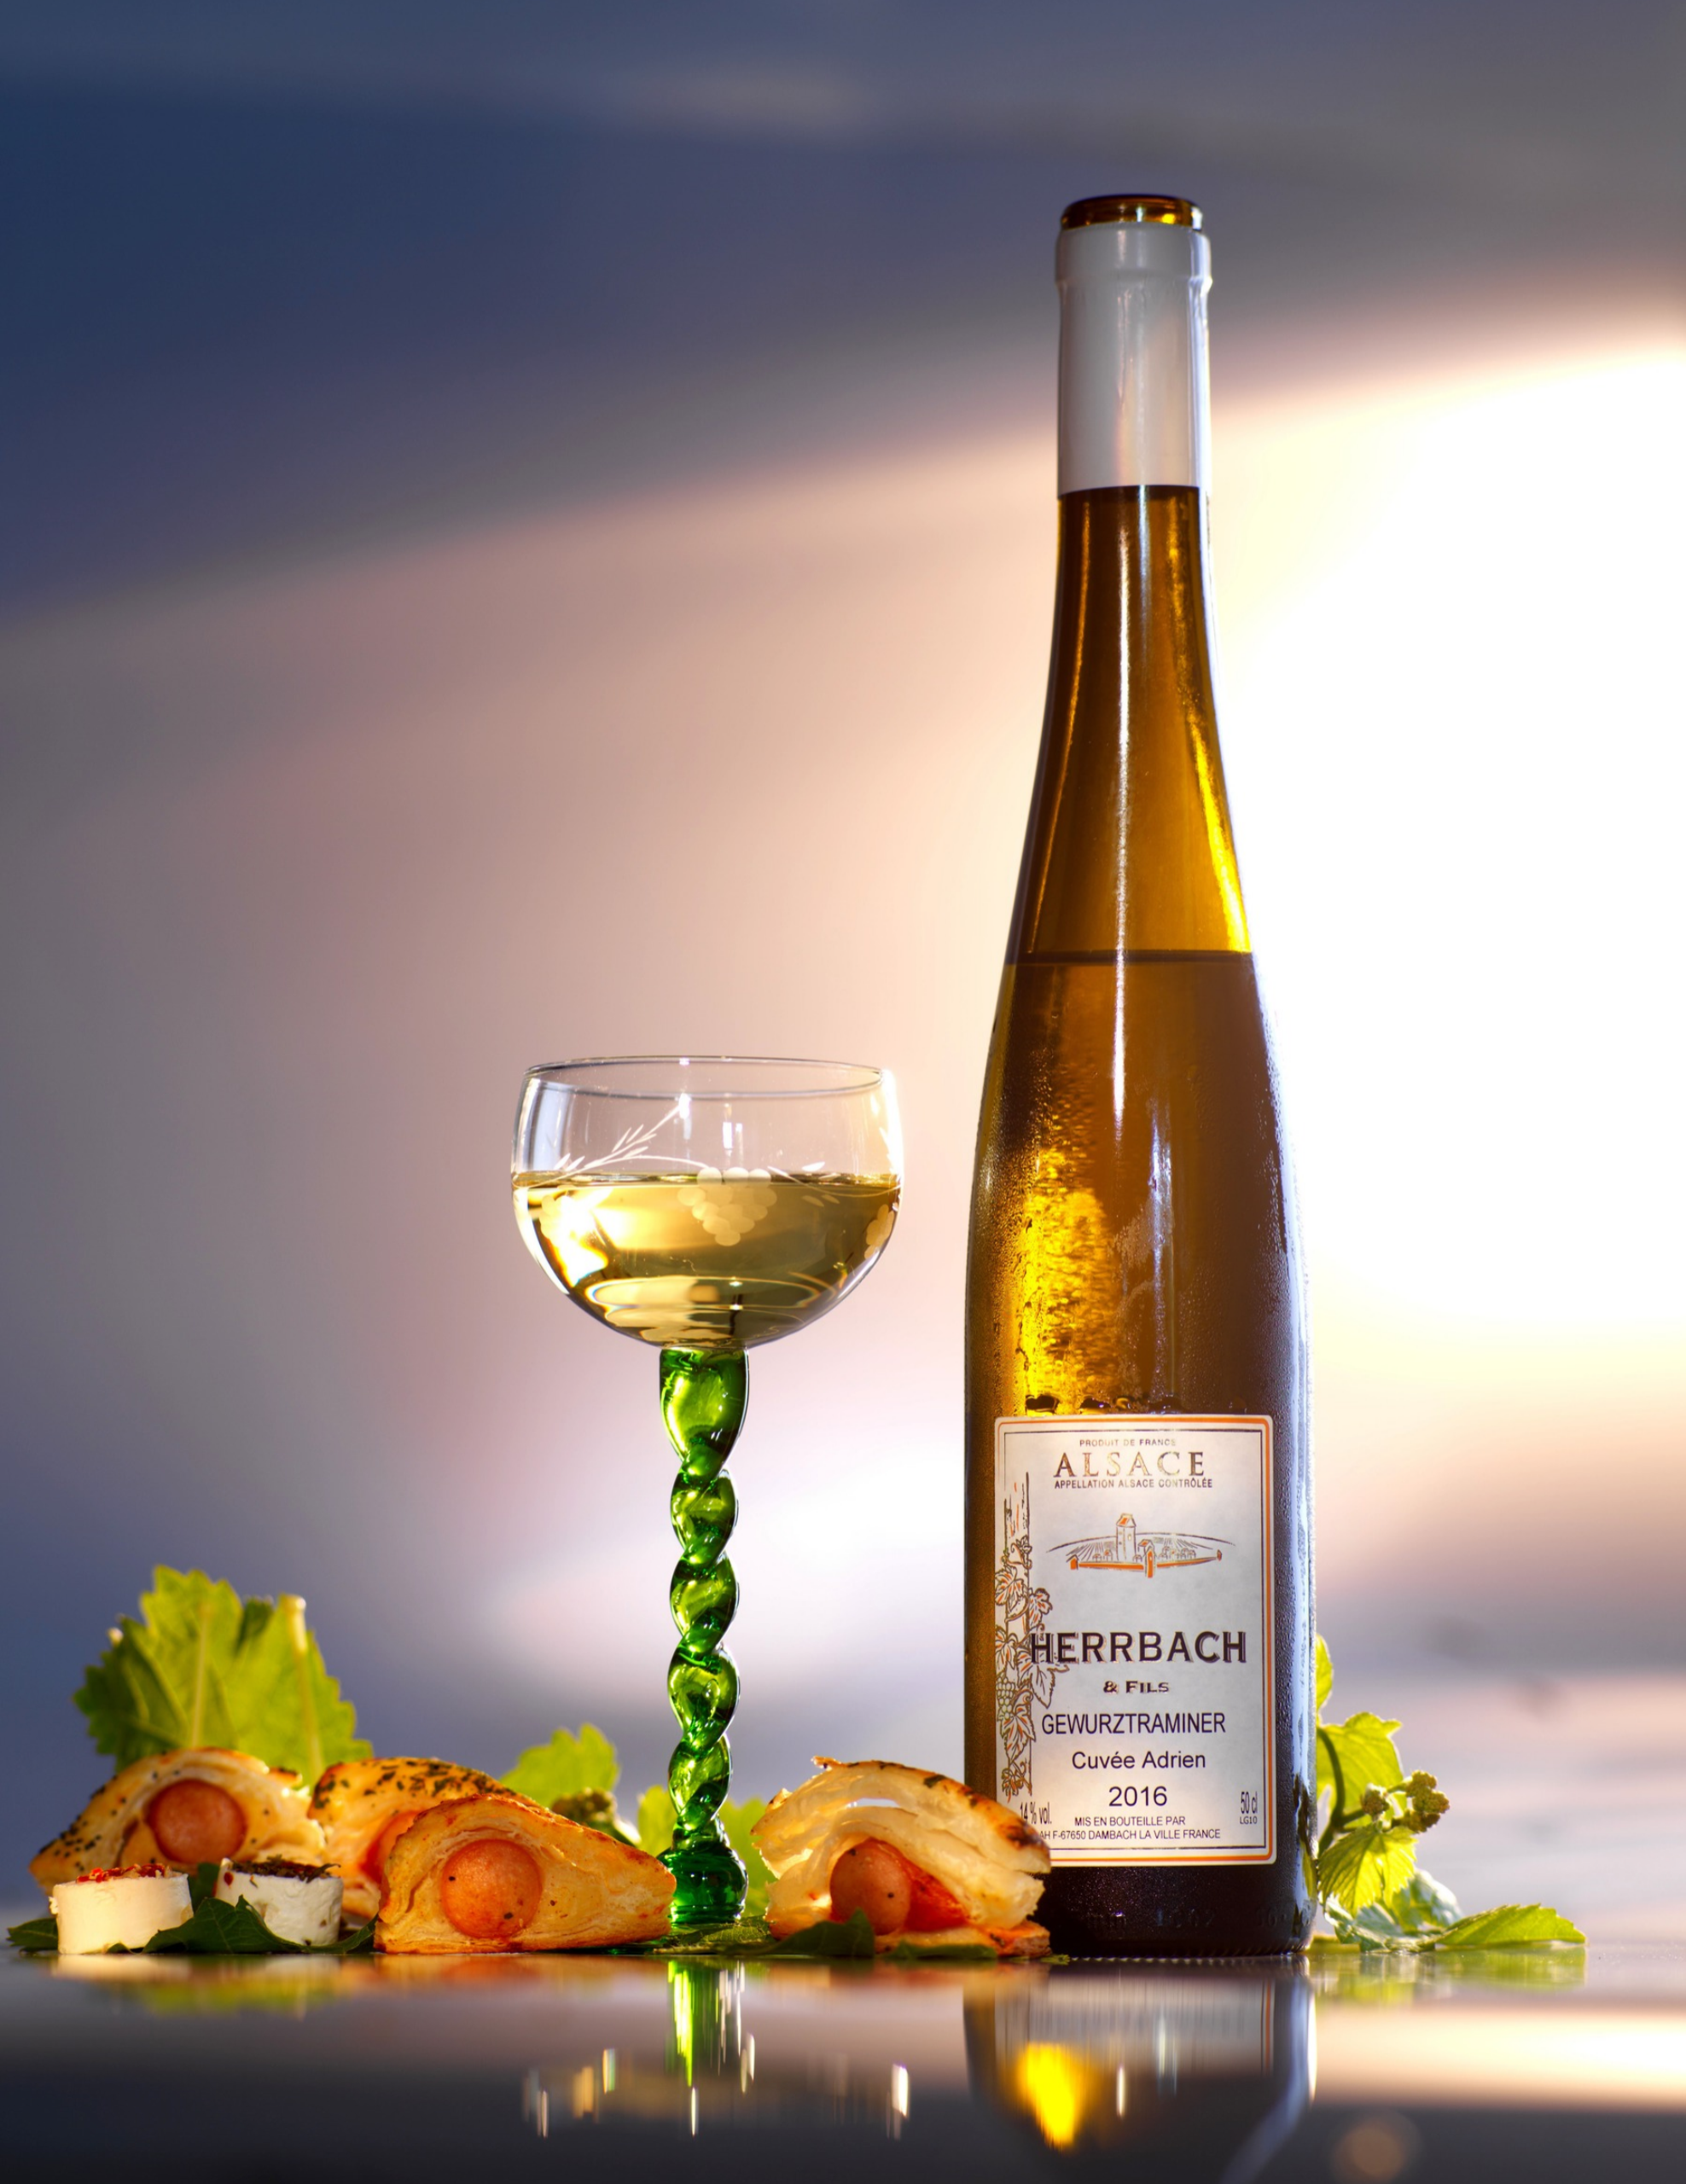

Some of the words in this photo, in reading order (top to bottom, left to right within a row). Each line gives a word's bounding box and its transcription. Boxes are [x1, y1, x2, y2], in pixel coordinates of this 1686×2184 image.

[1079, 1438, 1119, 1447] PRODUIT
[1123, 1438, 1136, 1447] DE
[1139, 1438, 1177, 1447] FRANCE
[1053, 1451, 1205, 1478] ALSACE
[1054, 1478, 1114, 1489] APPELLATION
[1118, 1478, 1155, 1488] ALSACE
[1159, 1477, 1213, 1488] CONTRÔLÉE
[1031, 1631, 1247, 1663] HERRBACH
[1103, 1681, 1118, 1693] &
[1125, 1681, 1170, 1693] FILS
[1042, 1712, 1226, 1734] GEWURZTRAMINER
[1072, 1751, 1136, 1769] Cuvée
[1142, 1751, 1206, 1769] Adrien
[1109, 1786, 1168, 1806] 2016
[1241, 1792, 1250, 1814] 50
[1020, 1802, 1028, 1823] 14
[1030, 1802, 1037, 1825] %
[1039, 1802, 1052, 1825] vol.
[1074, 1816, 1091, 1827] MIS
[1094, 1816, 1108, 1827] EN
[1109, 1816, 1163, 1827] BOUTEILLE
[1166, 1816, 1186, 1826] PAR
[1240, 1815, 1258, 1825] LG10
[1052, 1830, 1086, 1840] F-67650
[1089, 1830, 1137, 1840] DAMBACH
[1139, 1830, 1153, 1839] LA
[1154, 1830, 1181, 1839] VILLE
[1183, 1829, 1221, 1838] FRANCE
